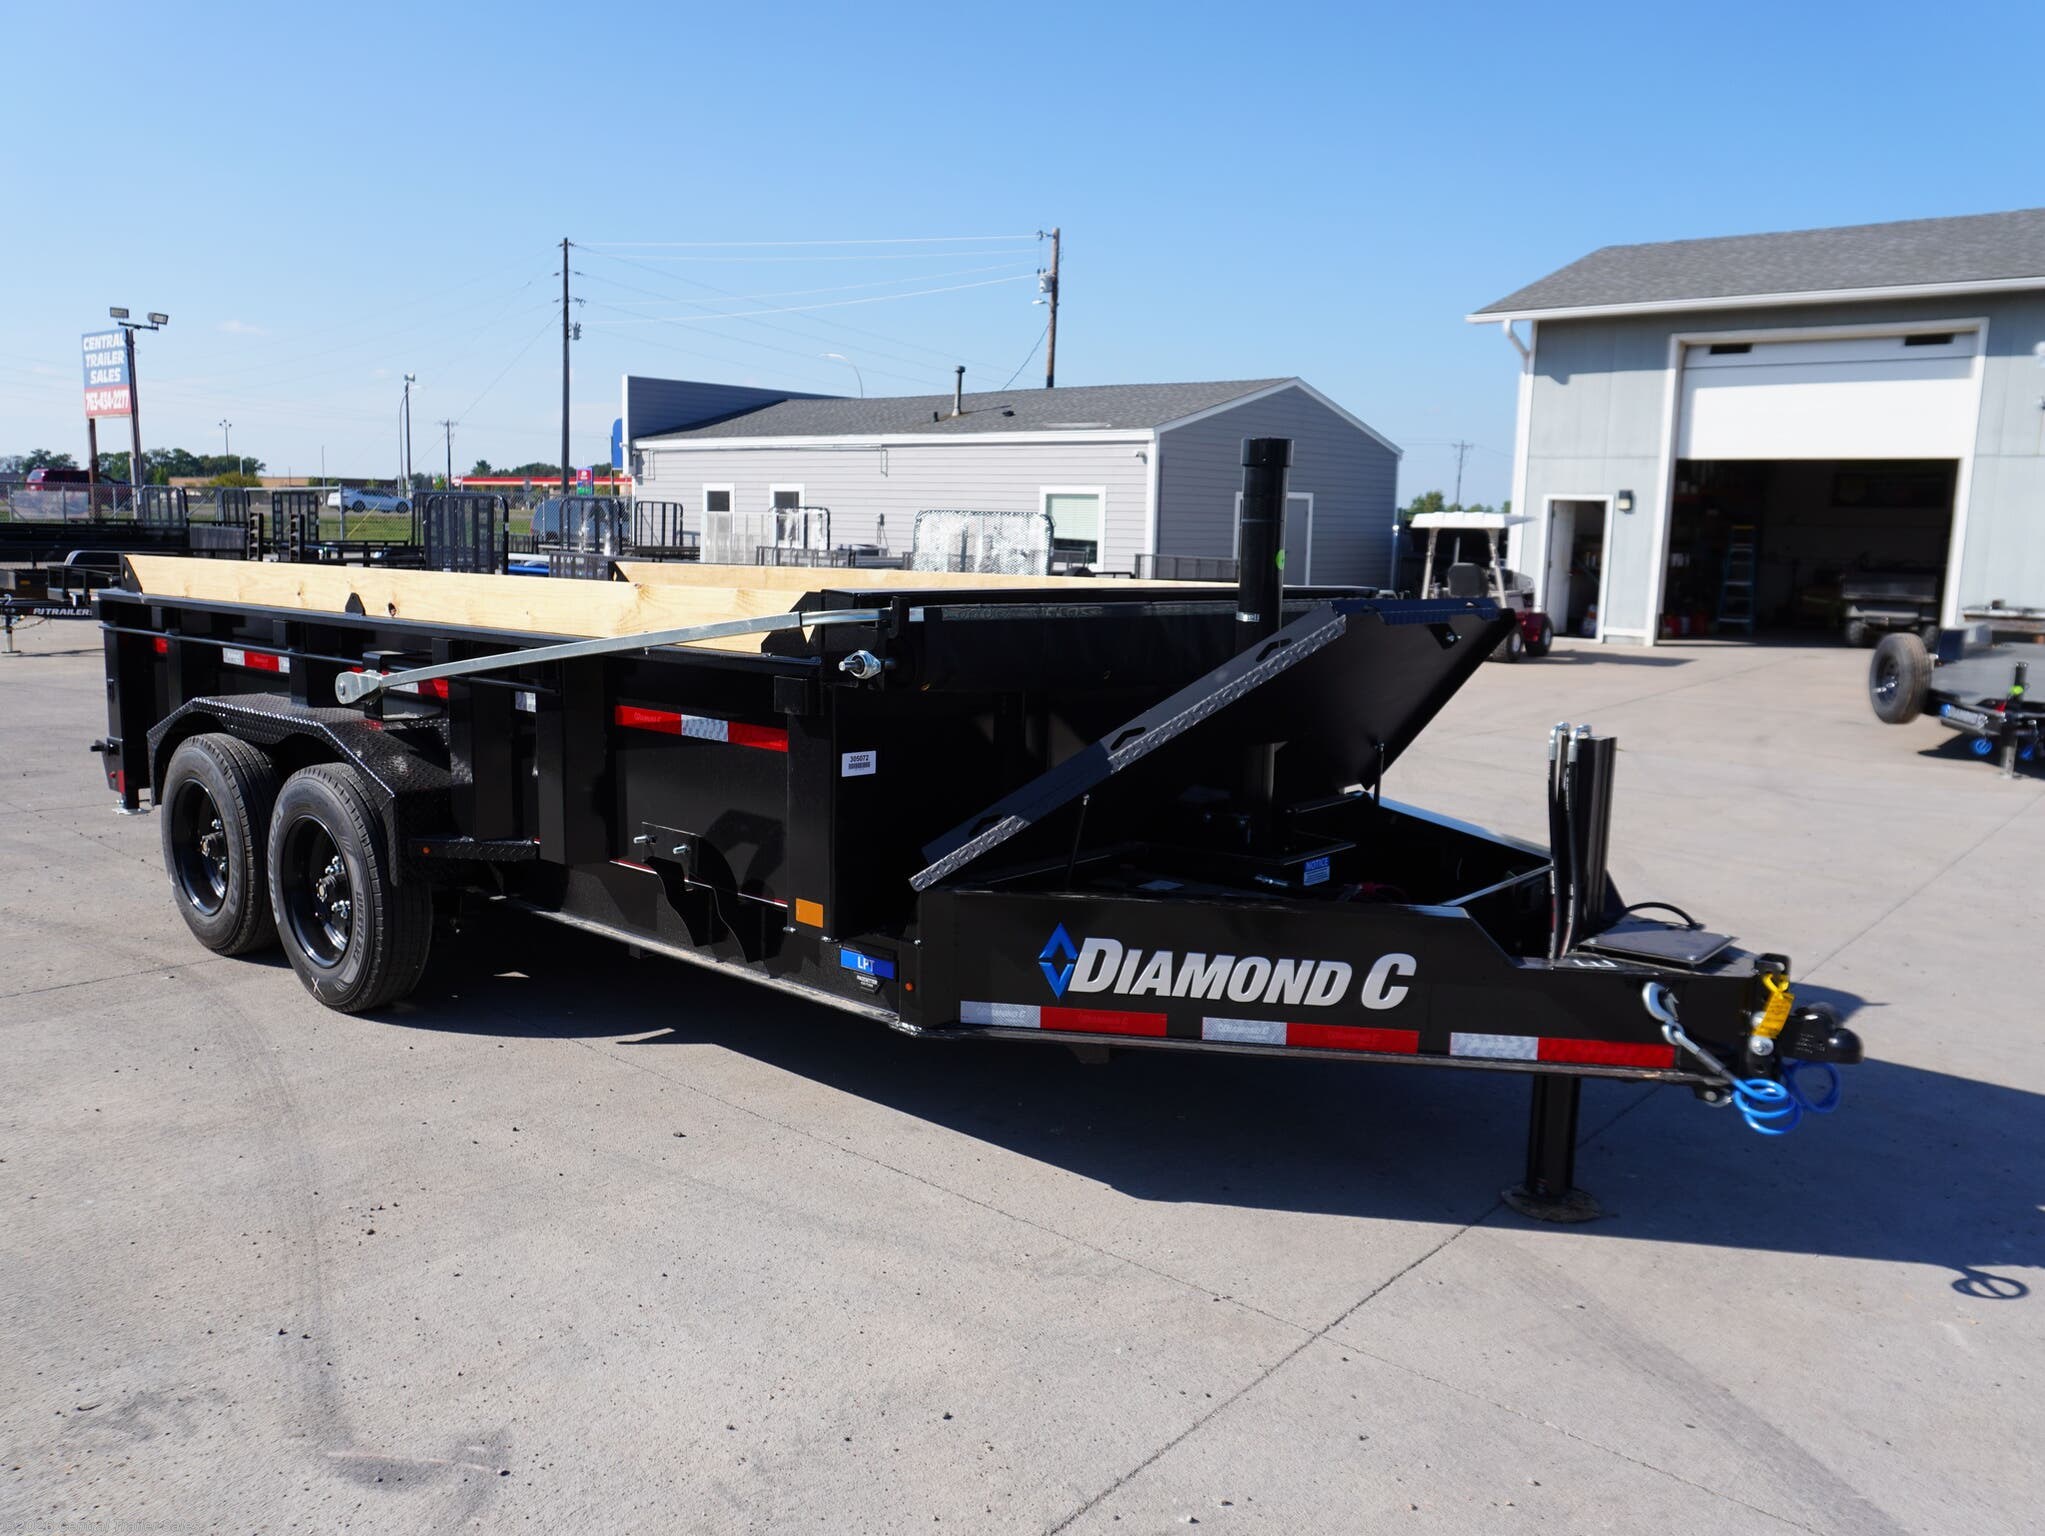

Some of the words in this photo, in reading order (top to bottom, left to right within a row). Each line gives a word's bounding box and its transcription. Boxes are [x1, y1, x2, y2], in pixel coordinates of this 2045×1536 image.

[83, 333, 125, 351] CENTRAL
[85, 350, 124, 368] TRAILER
[90, 368, 120, 385] SALES
[1068, 937, 1352, 1006] DIAMOND
[1361, 953, 1418, 1010] C
